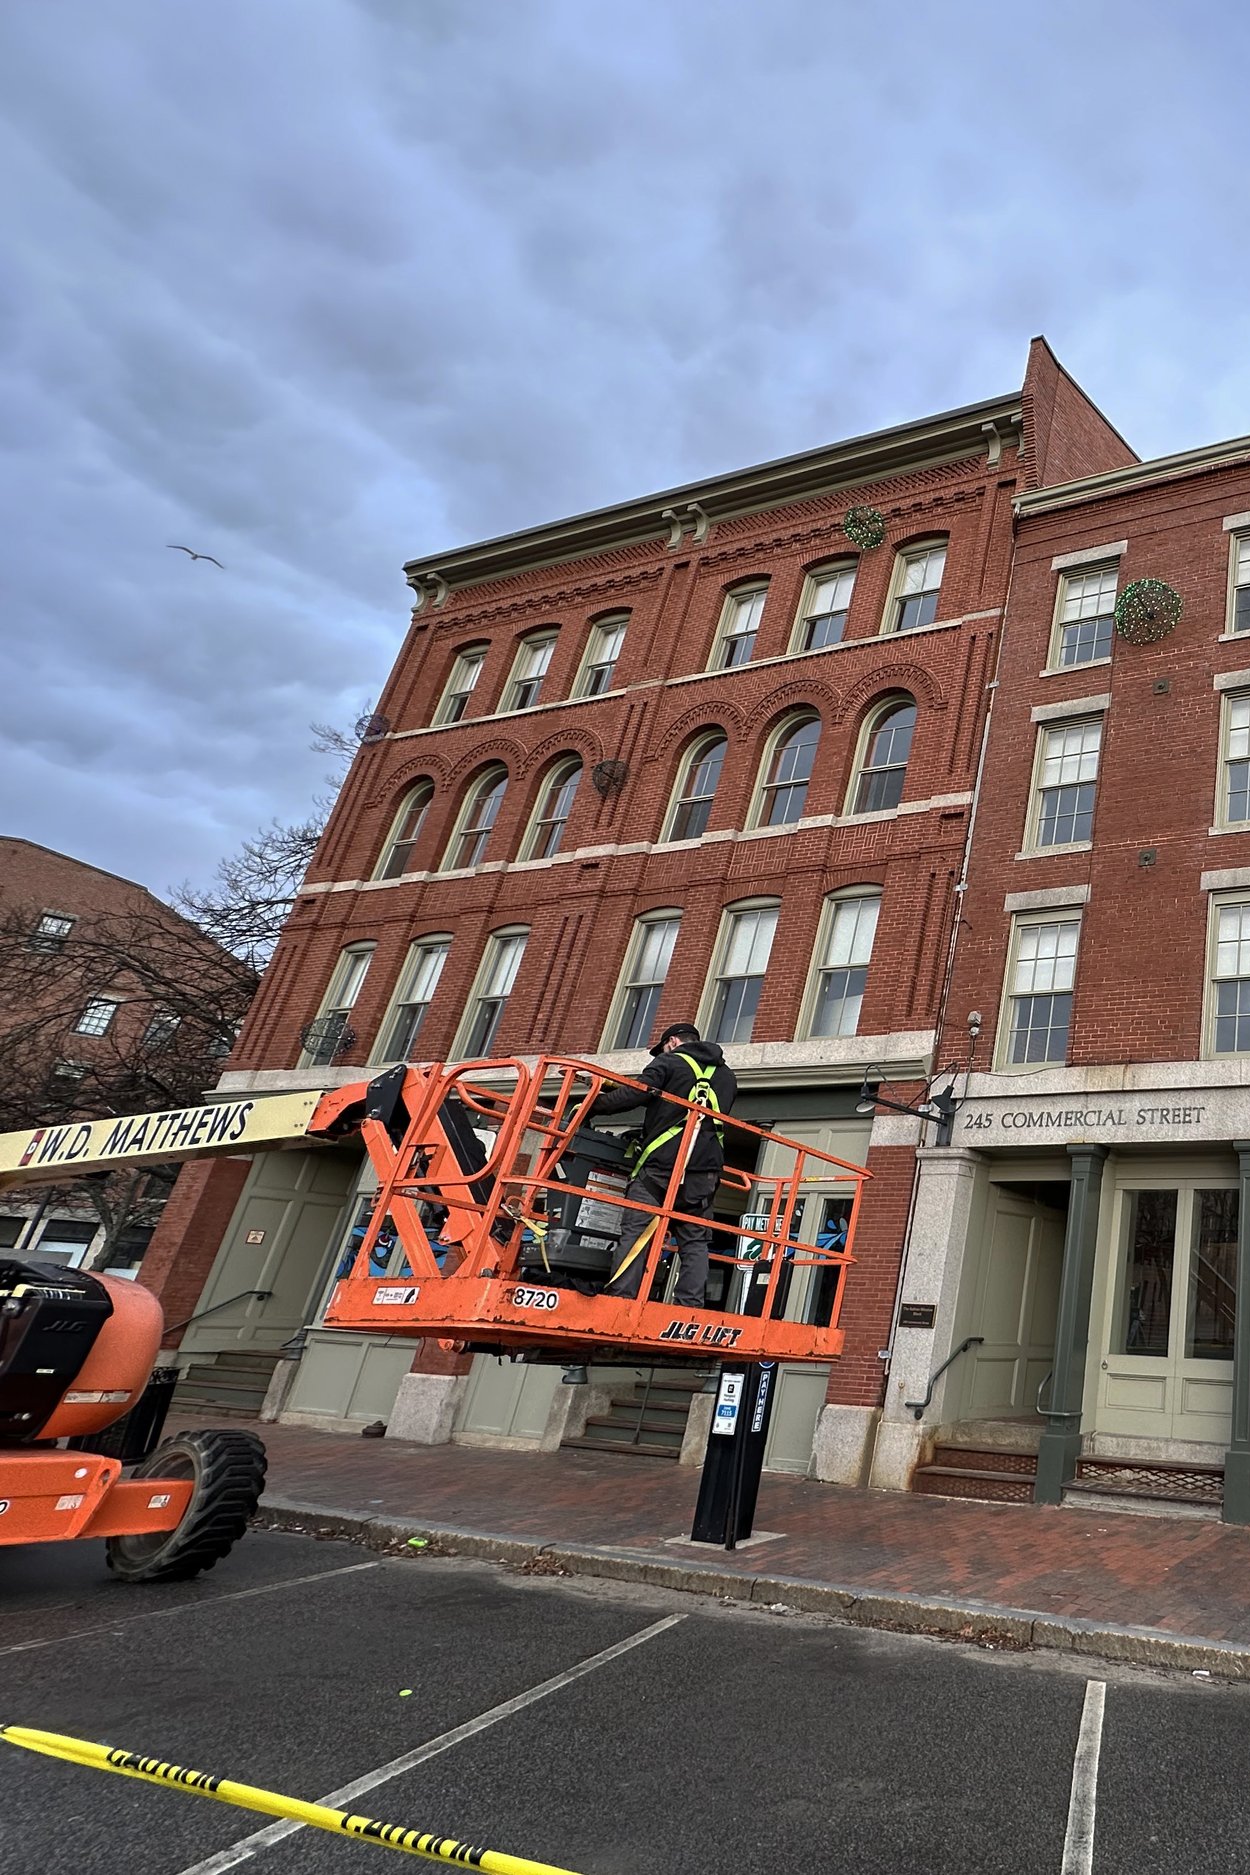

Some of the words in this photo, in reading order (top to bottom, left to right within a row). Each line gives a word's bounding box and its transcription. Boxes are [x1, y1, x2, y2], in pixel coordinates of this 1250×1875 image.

[964, 1113, 993, 1129] 245
[1001, 1109, 1127, 1129] COMMERCIAL
[1136, 1107, 1205, 1125] STREET
[37, 1125, 92, 1163] W.D.
[99, 1102, 254, 1156] MATTHEWS
[514, 1288, 558, 1309] 8720
[41, 1320, 88, 1332] JLG
[660, 1321, 700, 1340] JLG
[702, 1326, 742, 1345] LIFT
[760, 1374, 769, 1396] PAY
[753, 1398, 765, 1430] HERE
